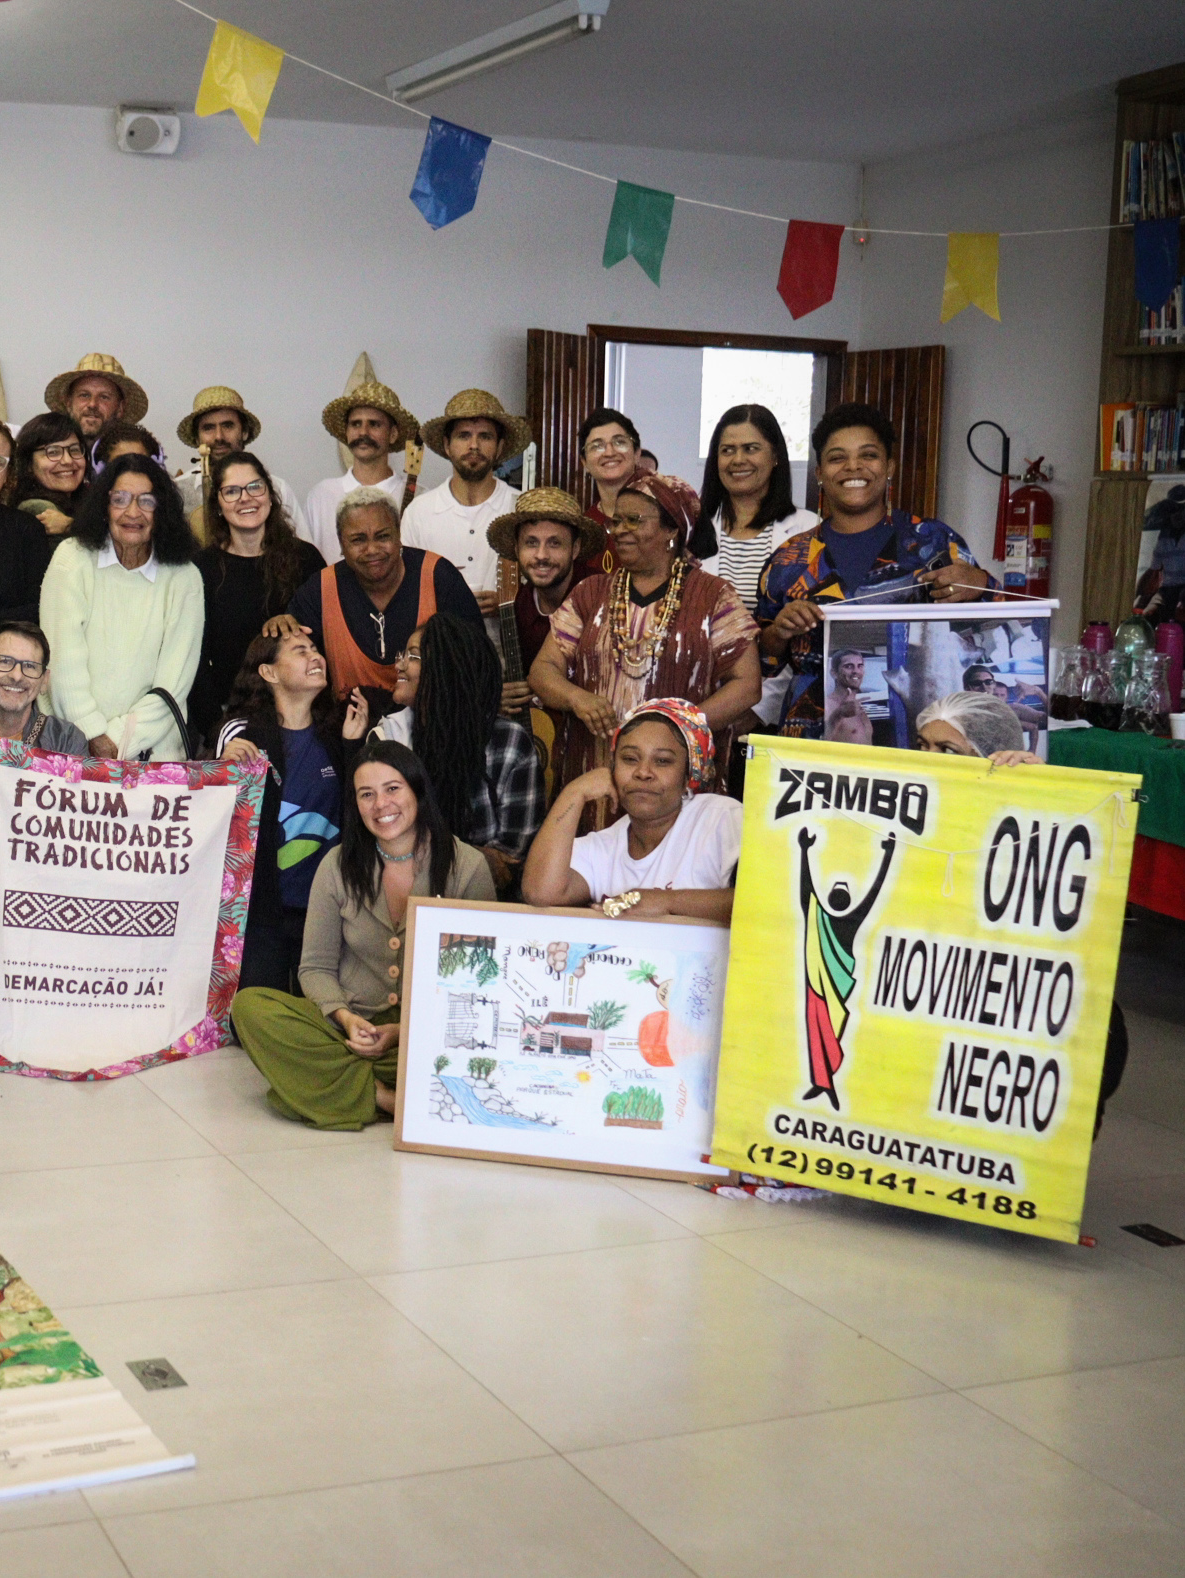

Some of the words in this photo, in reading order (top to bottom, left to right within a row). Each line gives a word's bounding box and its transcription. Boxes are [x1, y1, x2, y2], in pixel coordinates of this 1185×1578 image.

[13, 778, 129, 818] FÓRUM
[151, 795, 193, 822] DE
[8, 837, 190, 875] TRADICIONAIS
[10, 812, 194, 849] COMUNIDADES
[983, 815, 1092, 933] ONG
[4, 974, 128, 998] DEMARCAÇÃO
[134, 976, 164, 996] JÁ!
[873, 935, 1075, 1037] MOVIMENTO
[937, 1042, 1060, 1133] NEGRO
[774, 1114, 1016, 1185] CARAGUATATUBA
